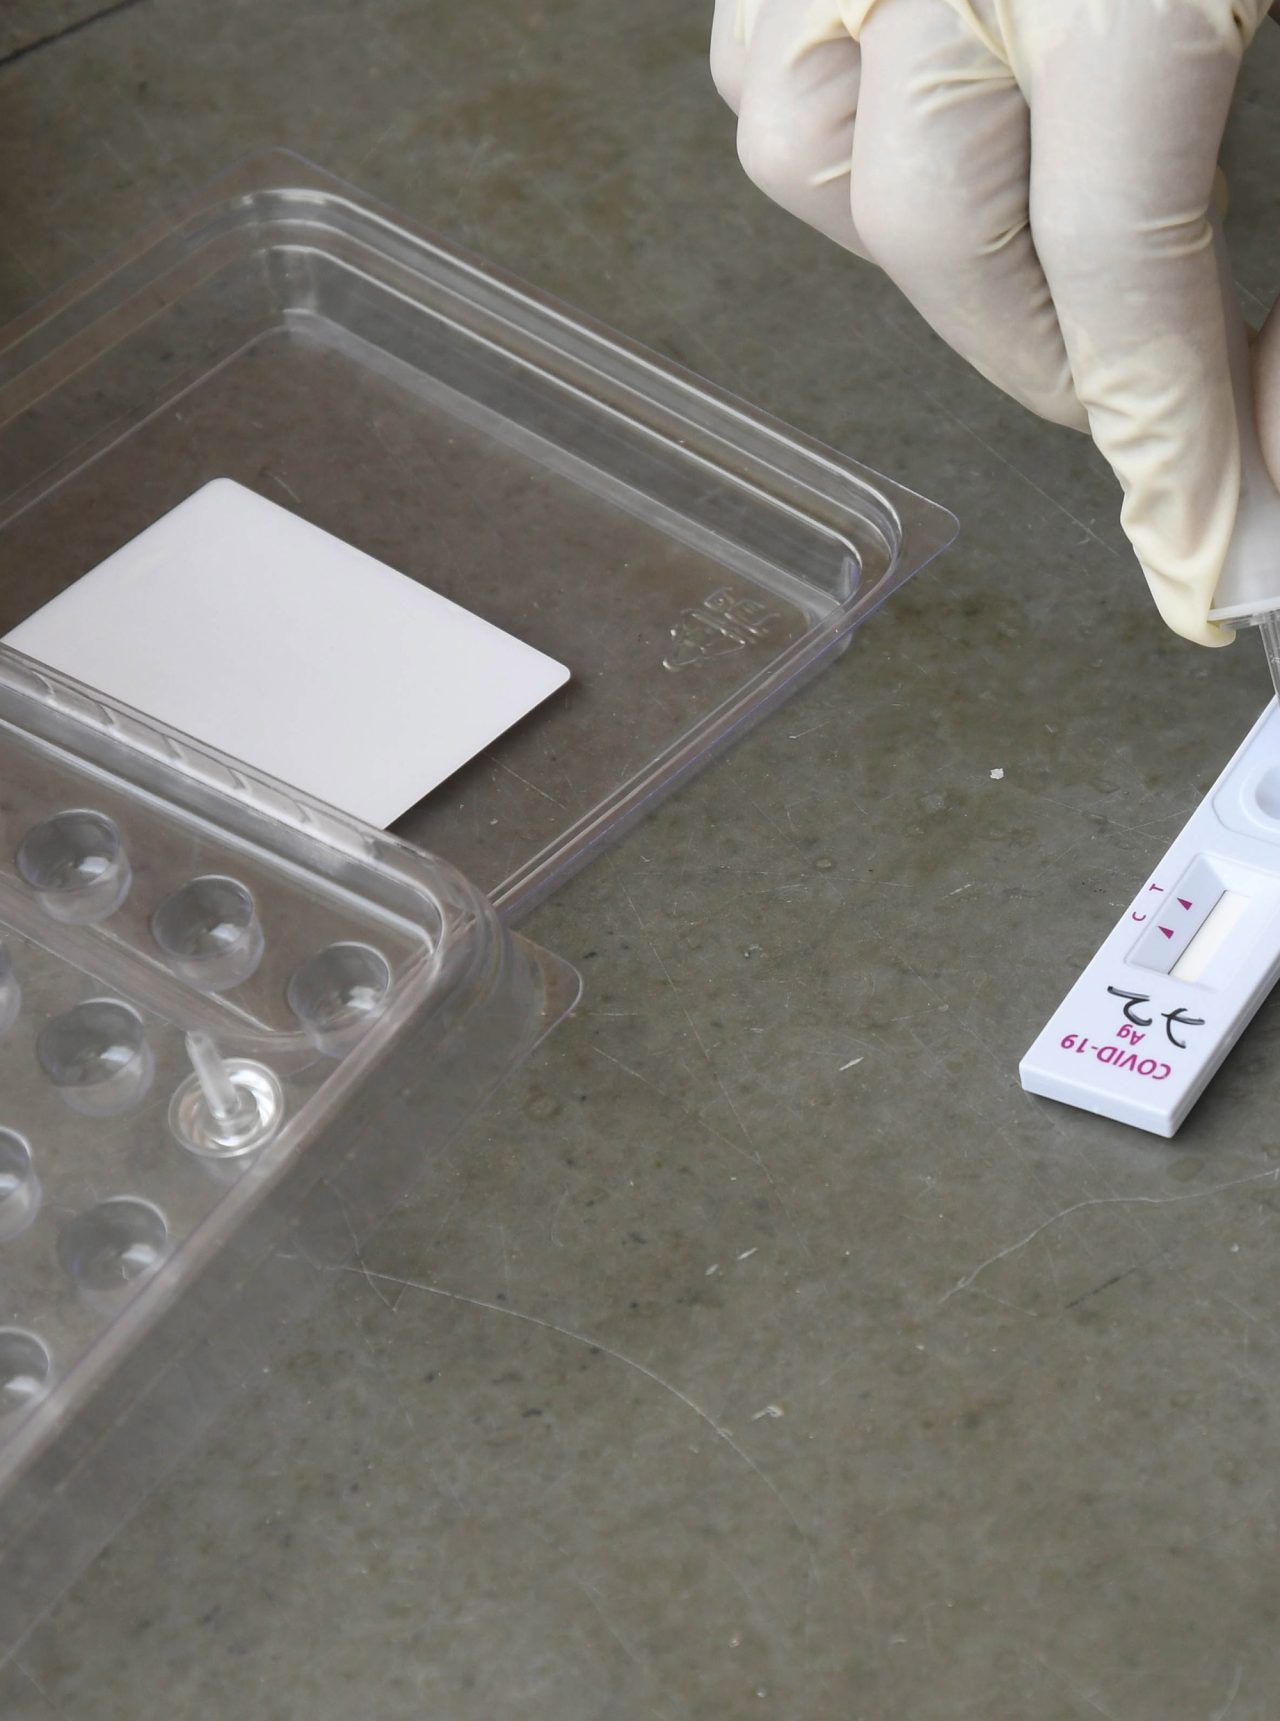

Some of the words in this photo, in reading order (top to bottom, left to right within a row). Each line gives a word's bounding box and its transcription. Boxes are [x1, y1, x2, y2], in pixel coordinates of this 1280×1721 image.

[1148, 882, 1165, 893] T
[1131, 910, 1147, 922] C
[1107, 986, 1205, 1049] 72
[1116, 1024, 1146, 1046] Ag
[1060, 1034, 1171, 1080] COVID-19
